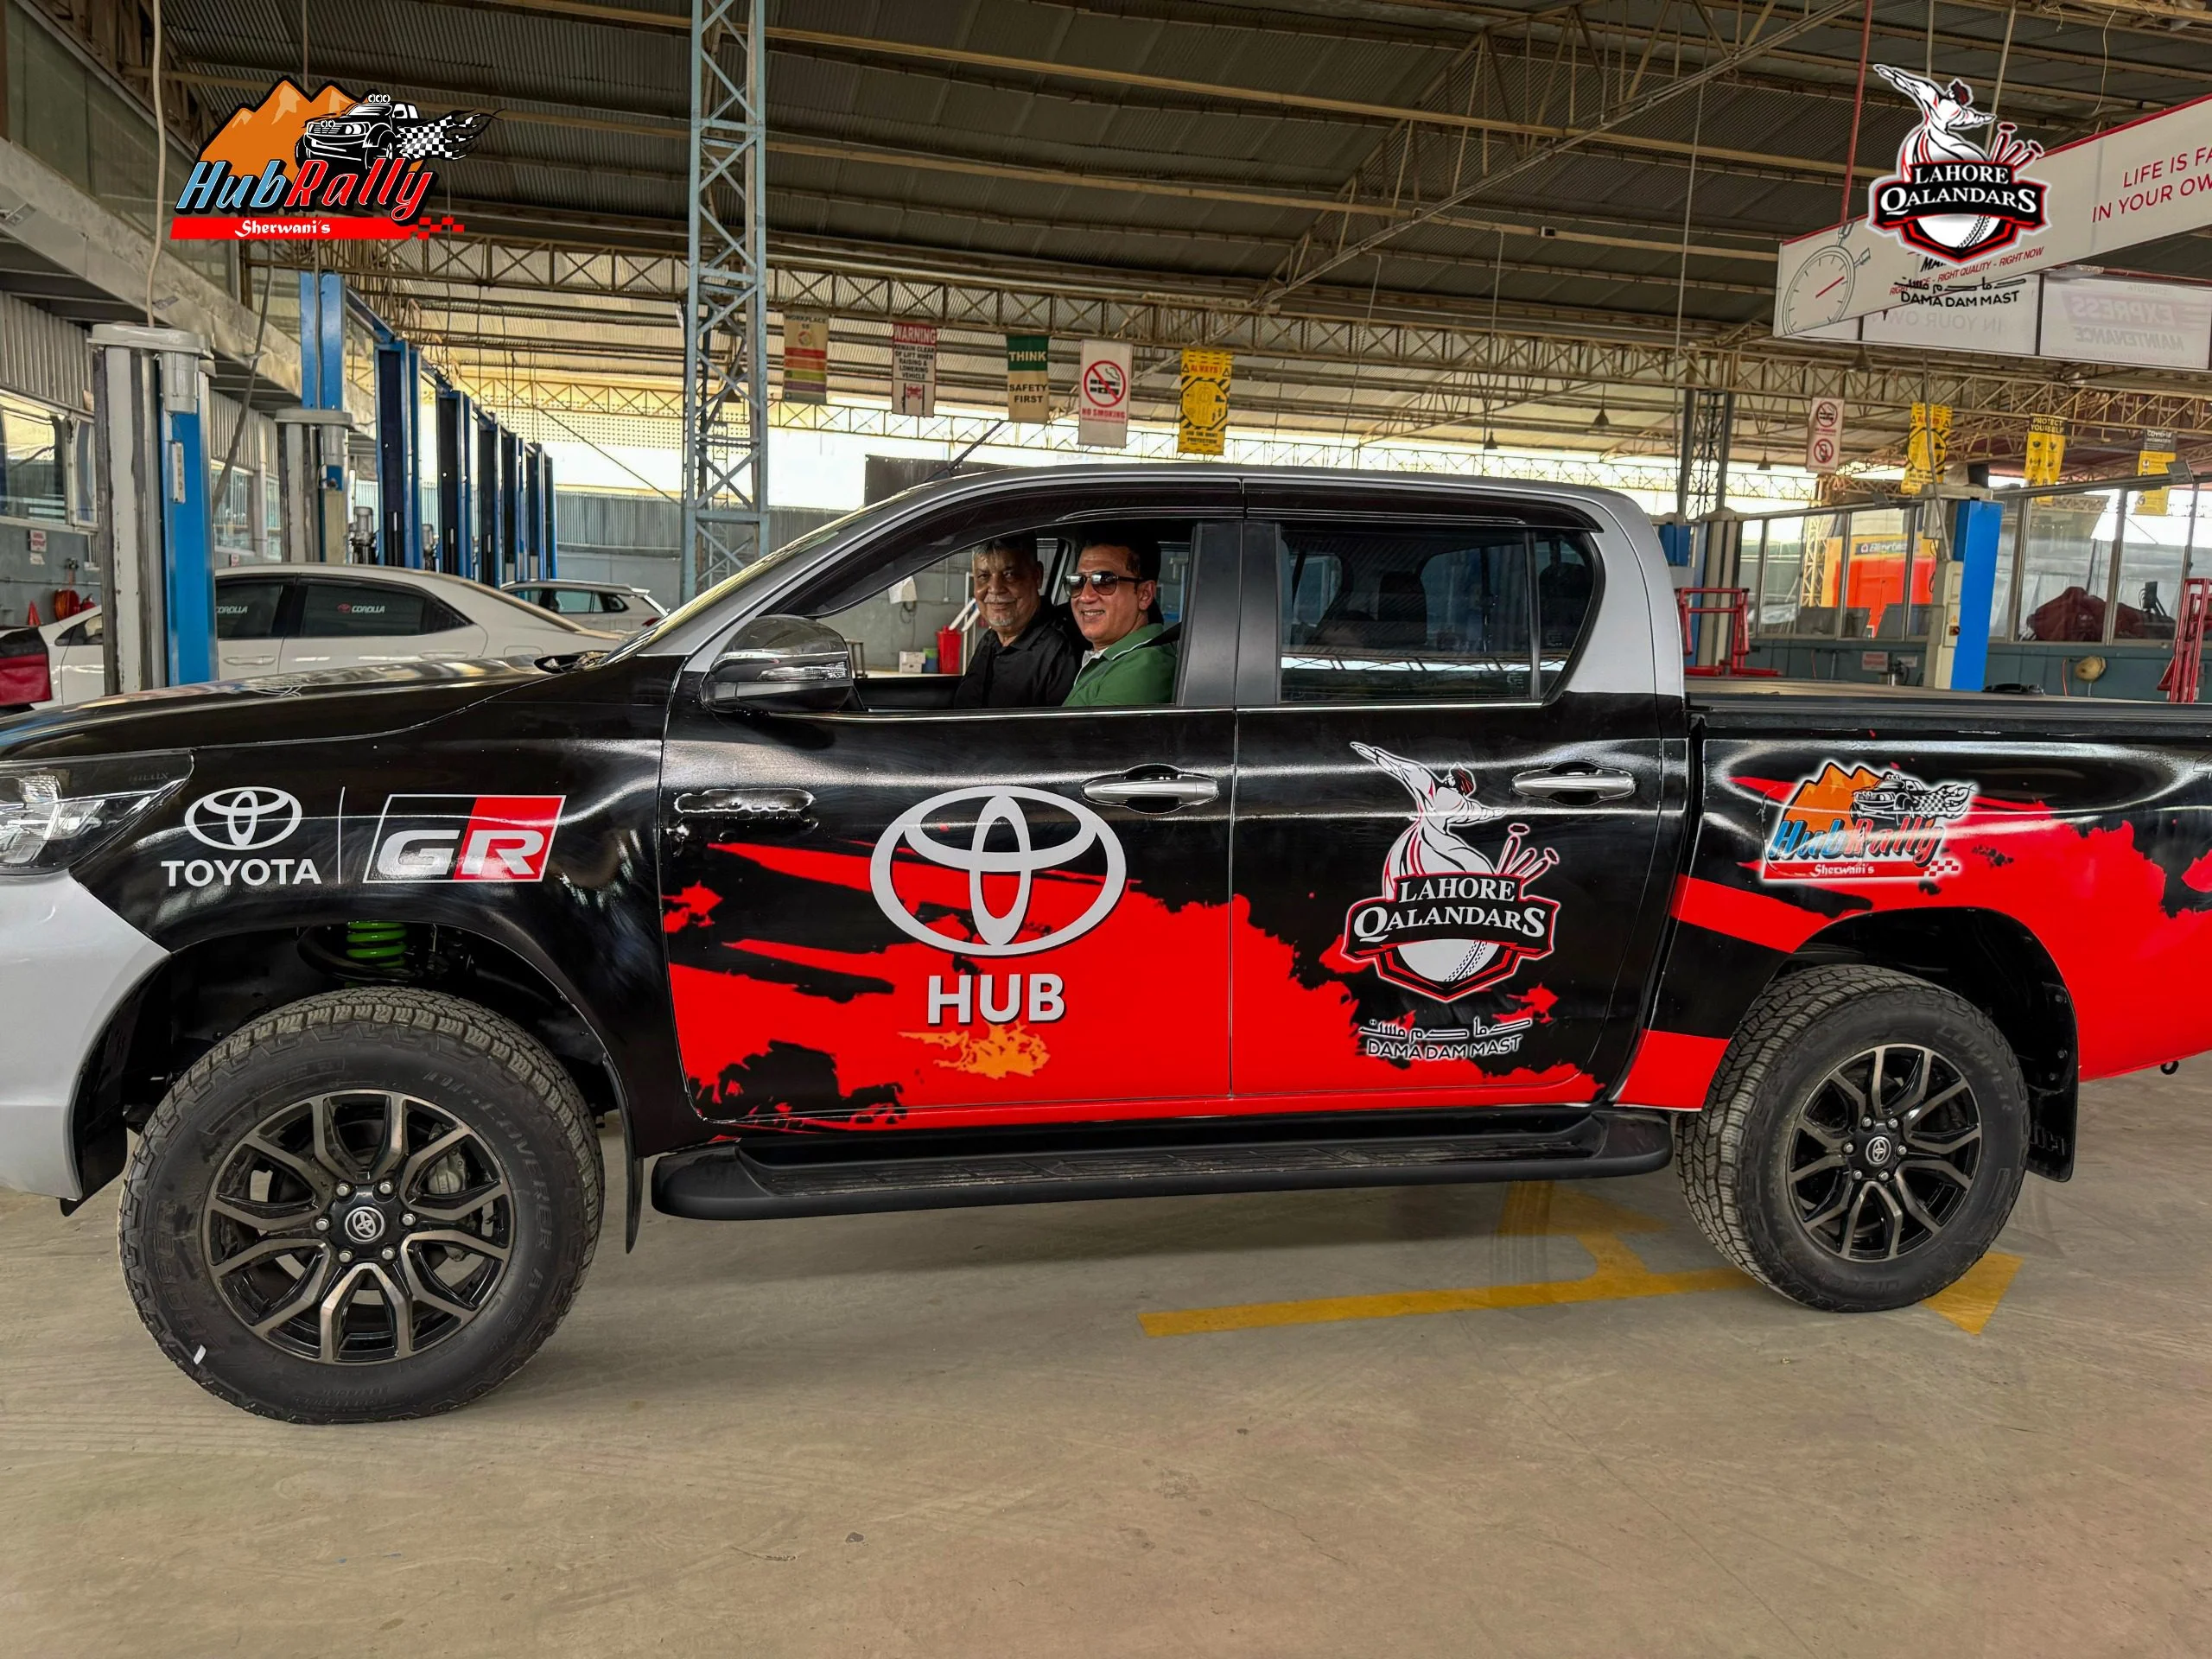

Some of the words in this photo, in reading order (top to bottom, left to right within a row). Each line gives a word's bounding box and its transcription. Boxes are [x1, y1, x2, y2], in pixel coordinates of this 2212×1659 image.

[2123, 161, 2164, 188] LIFE
[2170, 153, 2188, 174] IS
[2093, 202, 2112, 223] IN
[2119, 185, 2173, 214] YOUR
[1937, 270, 1959, 283] RIGHT
[1960, 261, 1992, 276] QUALITY
[1999, 253, 2024, 266] RIGHT
[2024, 246, 2044, 260] NOW
[894, 325, 936, 344] WARNING
[1008, 351, 1046, 362] THINK
[1009, 384, 1048, 392] SAFETY
[1014, 395, 1044, 404] FIRST
[1093, 409, 1125, 419] SMOKING
[377, 830, 544, 876] GR
[161, 859, 322, 887] TOYOTA
[1810, 863, 1875, 877] Sherwani's
[1398, 876, 1516, 903] LAHORE
[1354, 906, 1546, 942] QALANDARS
[927, 973, 1065, 1025] HUB
[1367, 1039, 1422, 1059] DAMA
[1426, 1045, 1467, 1059] DAM
[1471, 1035, 1523, 1058] MAST
